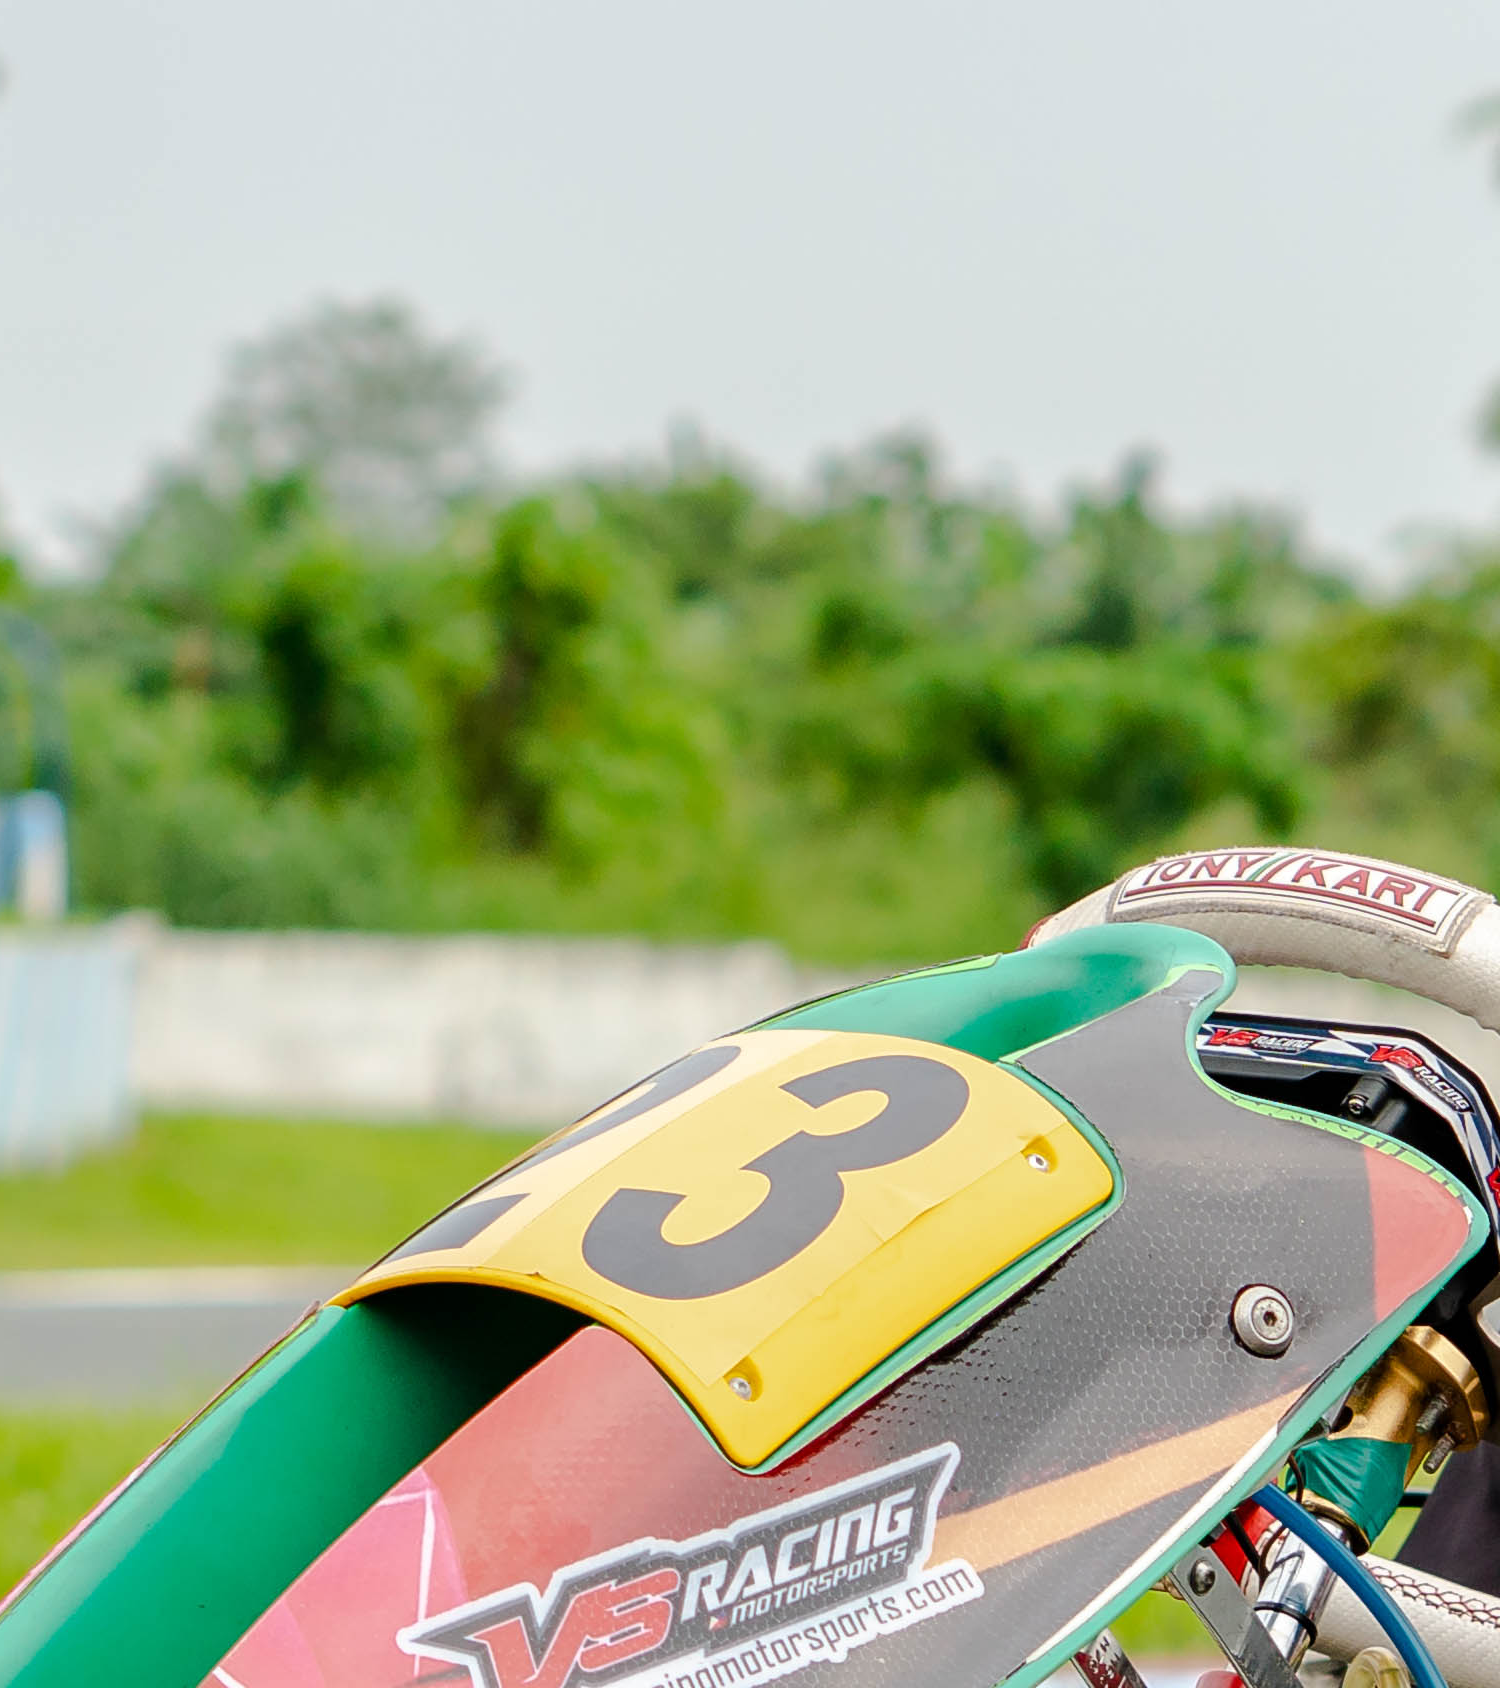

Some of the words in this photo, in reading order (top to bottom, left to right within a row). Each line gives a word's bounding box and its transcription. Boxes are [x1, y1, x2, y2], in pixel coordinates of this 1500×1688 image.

[1143, 855, 1270, 887] TONY
[1291, 858, 1458, 913] KART
[680, 1486, 918, 1626] RACING
[730, 1542, 909, 1626] MOTORSPORTS
